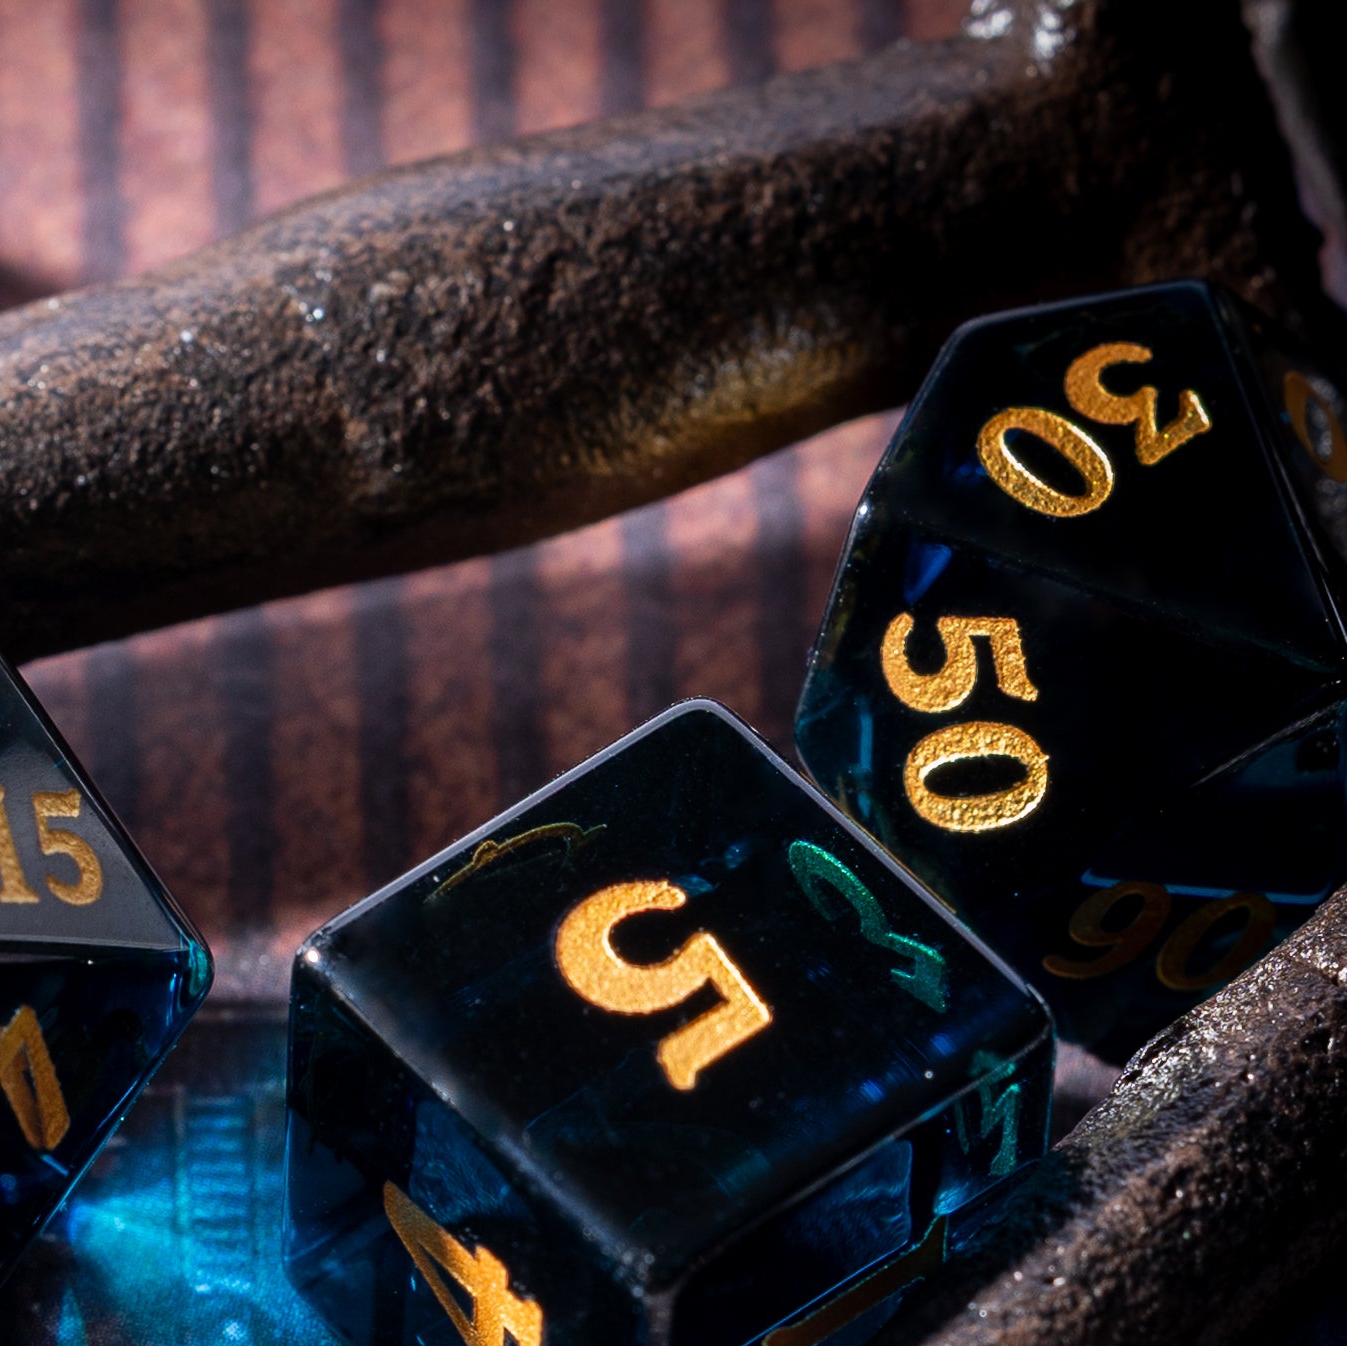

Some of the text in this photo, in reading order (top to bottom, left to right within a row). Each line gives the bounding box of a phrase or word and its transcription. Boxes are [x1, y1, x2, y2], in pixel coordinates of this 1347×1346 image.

[977, 341, 1212, 519] 30
[879, 611, 1049, 834] 50
[554, 878, 775, 1093] 5
